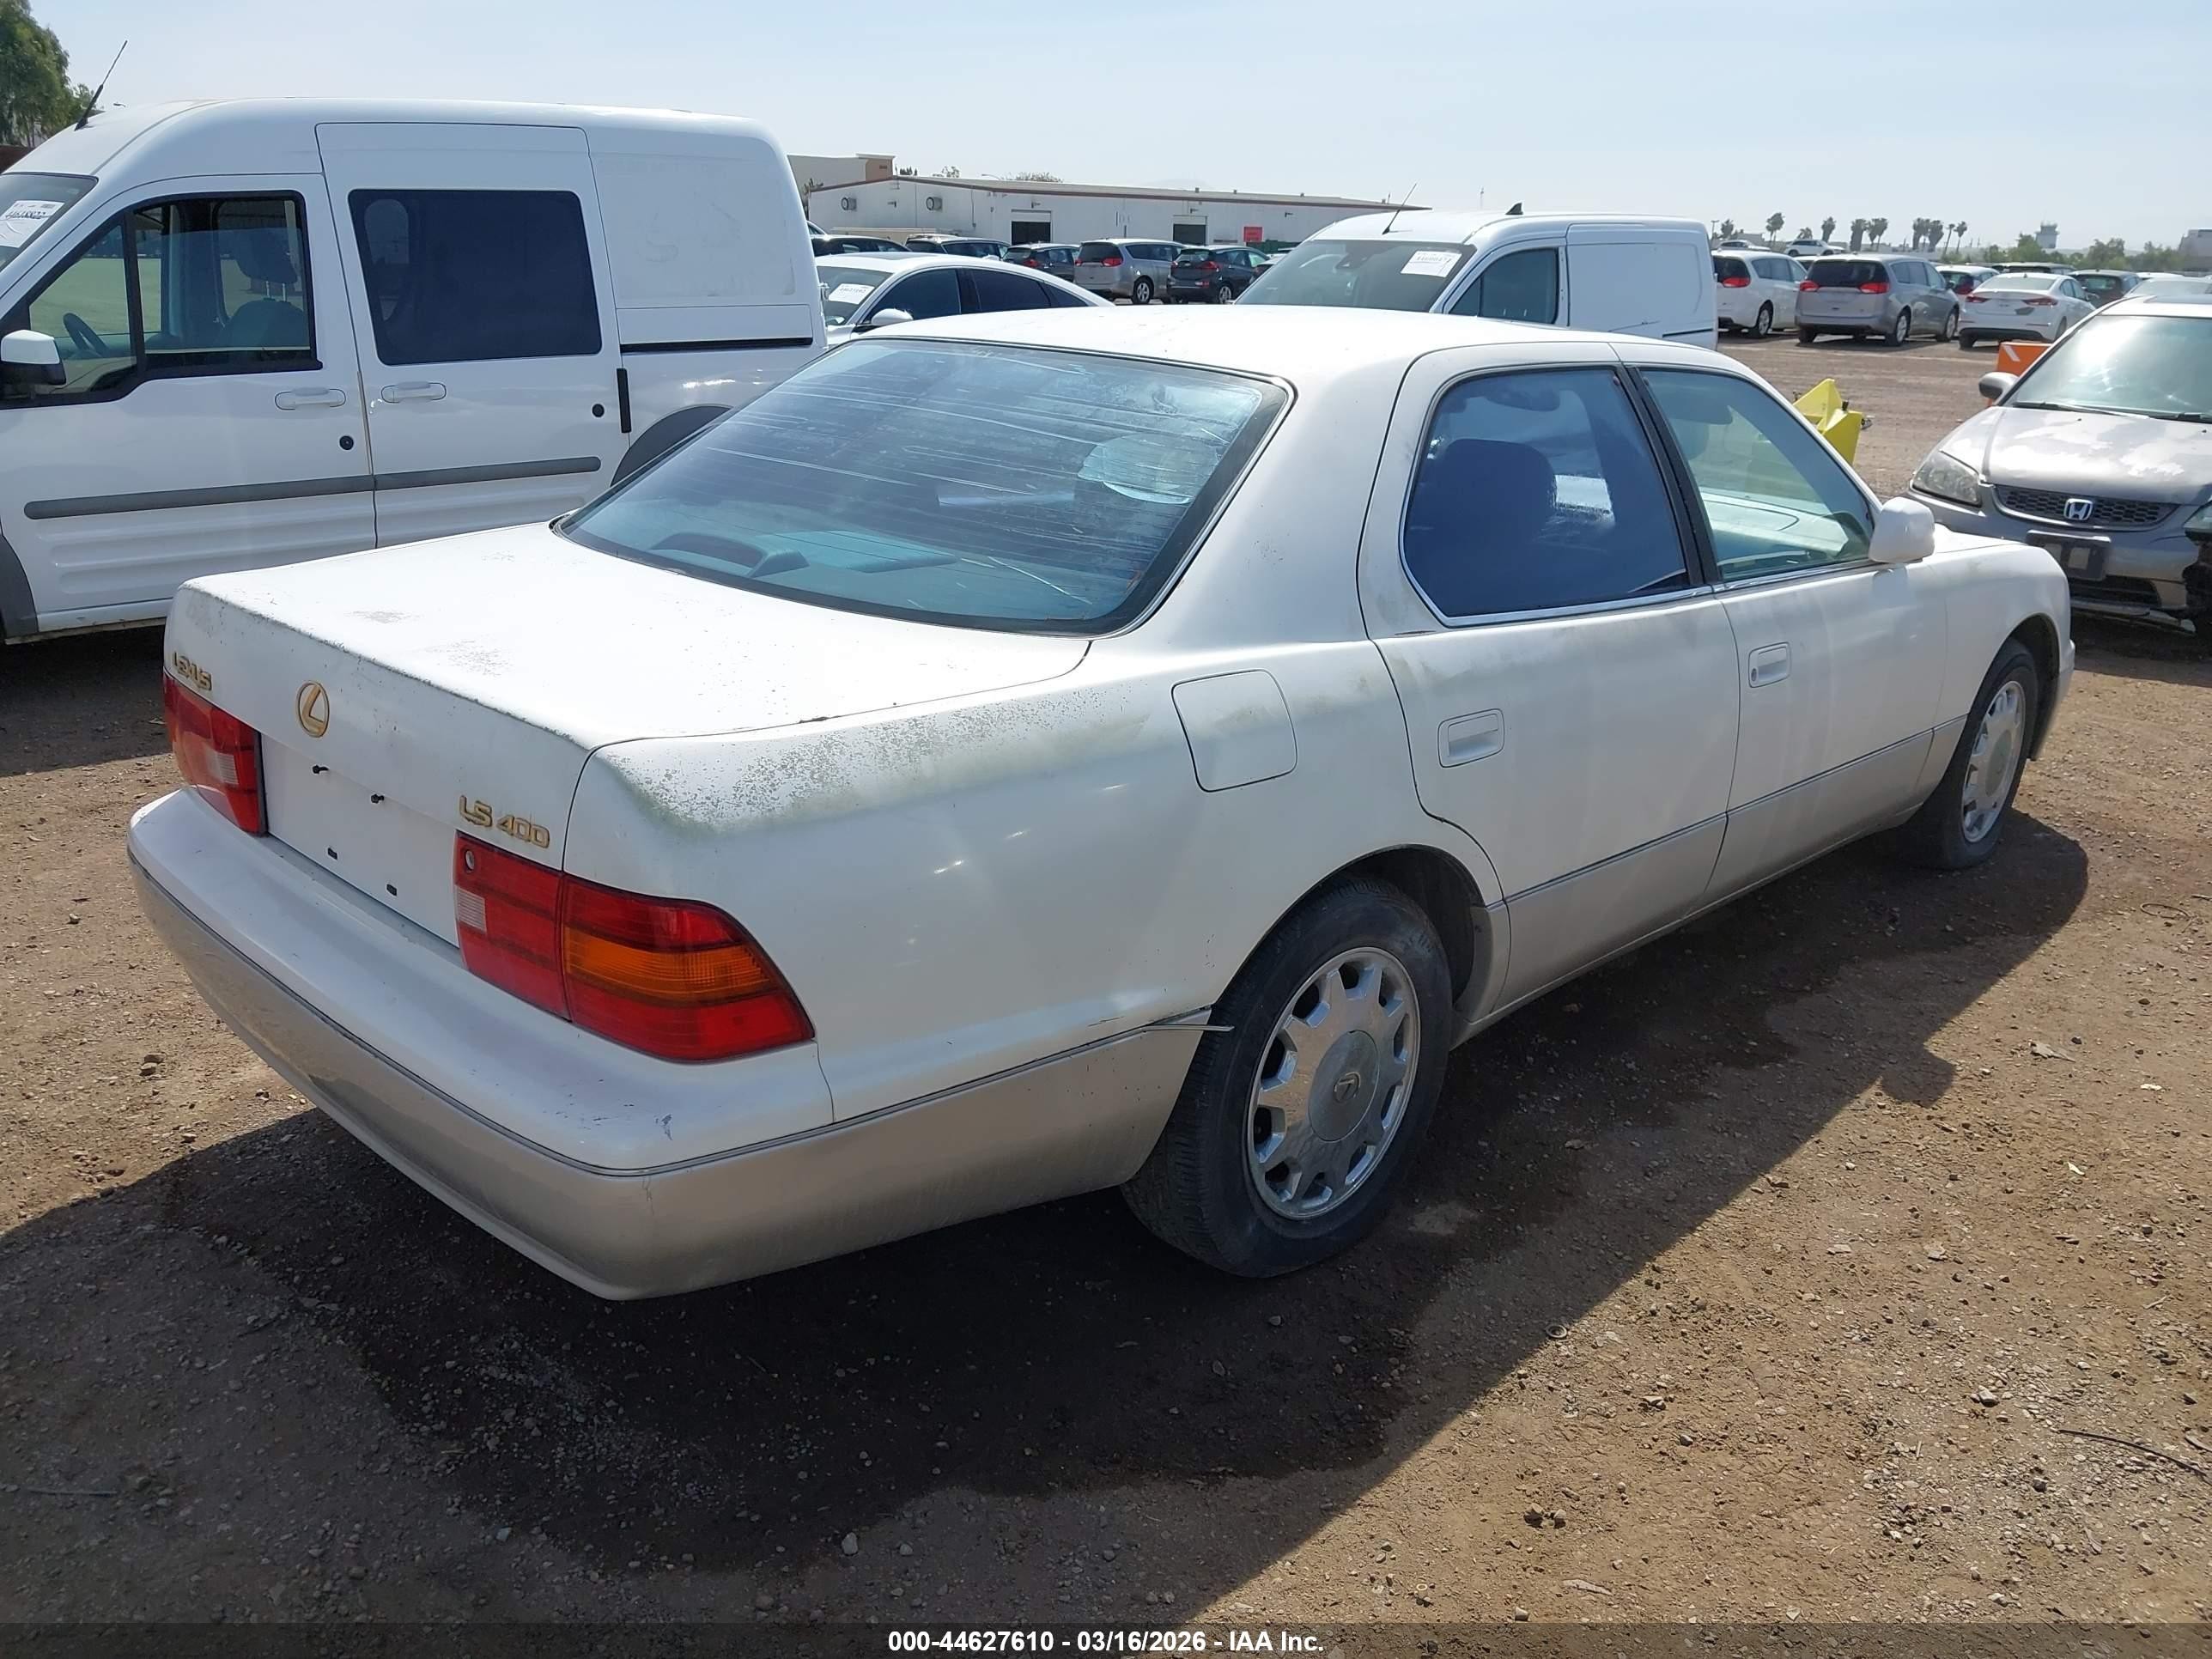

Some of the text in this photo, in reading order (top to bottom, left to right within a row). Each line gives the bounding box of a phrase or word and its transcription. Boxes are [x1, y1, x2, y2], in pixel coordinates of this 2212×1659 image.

[172, 651, 212, 691] LEXUS
[459, 794, 550, 849] LS 400
